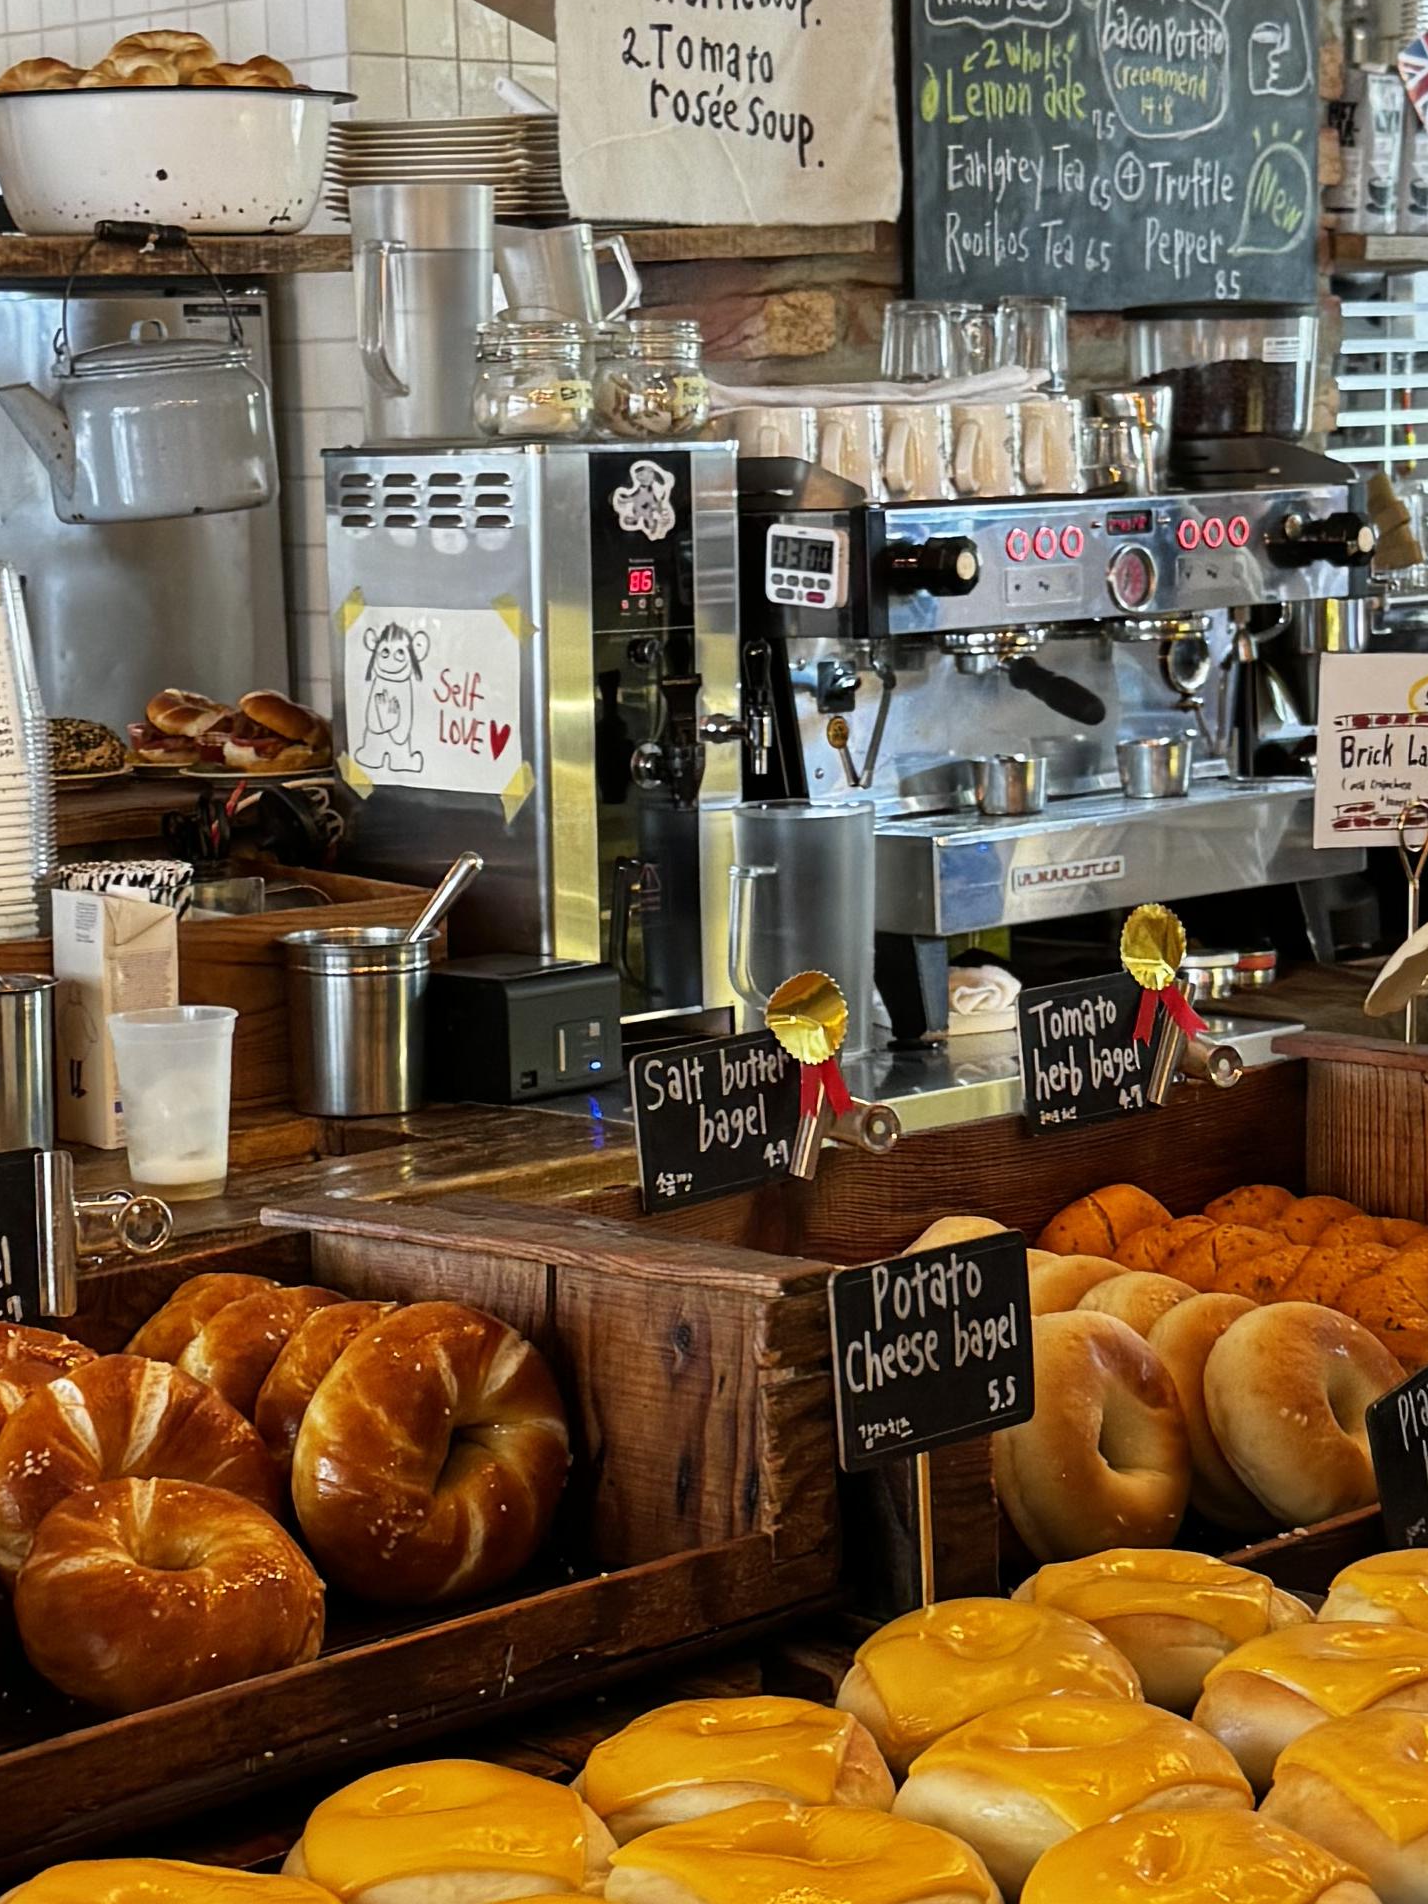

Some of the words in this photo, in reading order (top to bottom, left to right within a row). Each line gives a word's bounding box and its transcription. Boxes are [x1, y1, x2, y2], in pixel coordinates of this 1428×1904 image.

[947, 68, 1032, 123] Lemon
[947, 137, 1044, 212] Earlgrey
[1052, 144, 1085, 192] Tea
[1148, 157, 1234, 209] Truffle
[1254, 161, 1303, 233] New
[946, 209, 1029, 274] Rooibos
[1040, 219, 1073, 269] Tea
[1145, 216, 1223, 280] Pepper
[630, 568, 653, 593] 86
[434, 668, 484, 713] Self
[439, 716, 484, 755] LOVE
[1341, 734, 1394, 769] Brick
[1028, 995, 1117, 1047] Tomato
[644, 1057, 704, 1111] Salt
[720, 1048, 789, 1096] butter
[1034, 1045, 1083, 1101] herb
[1089, 1039, 1140, 1089] bagel
[699, 1093, 767, 1152] bagel
[872, 1252, 982, 1331] Potato
[954, 1302, 1018, 1367] bagel
[988, 1376, 1017, 1412] 5.5
